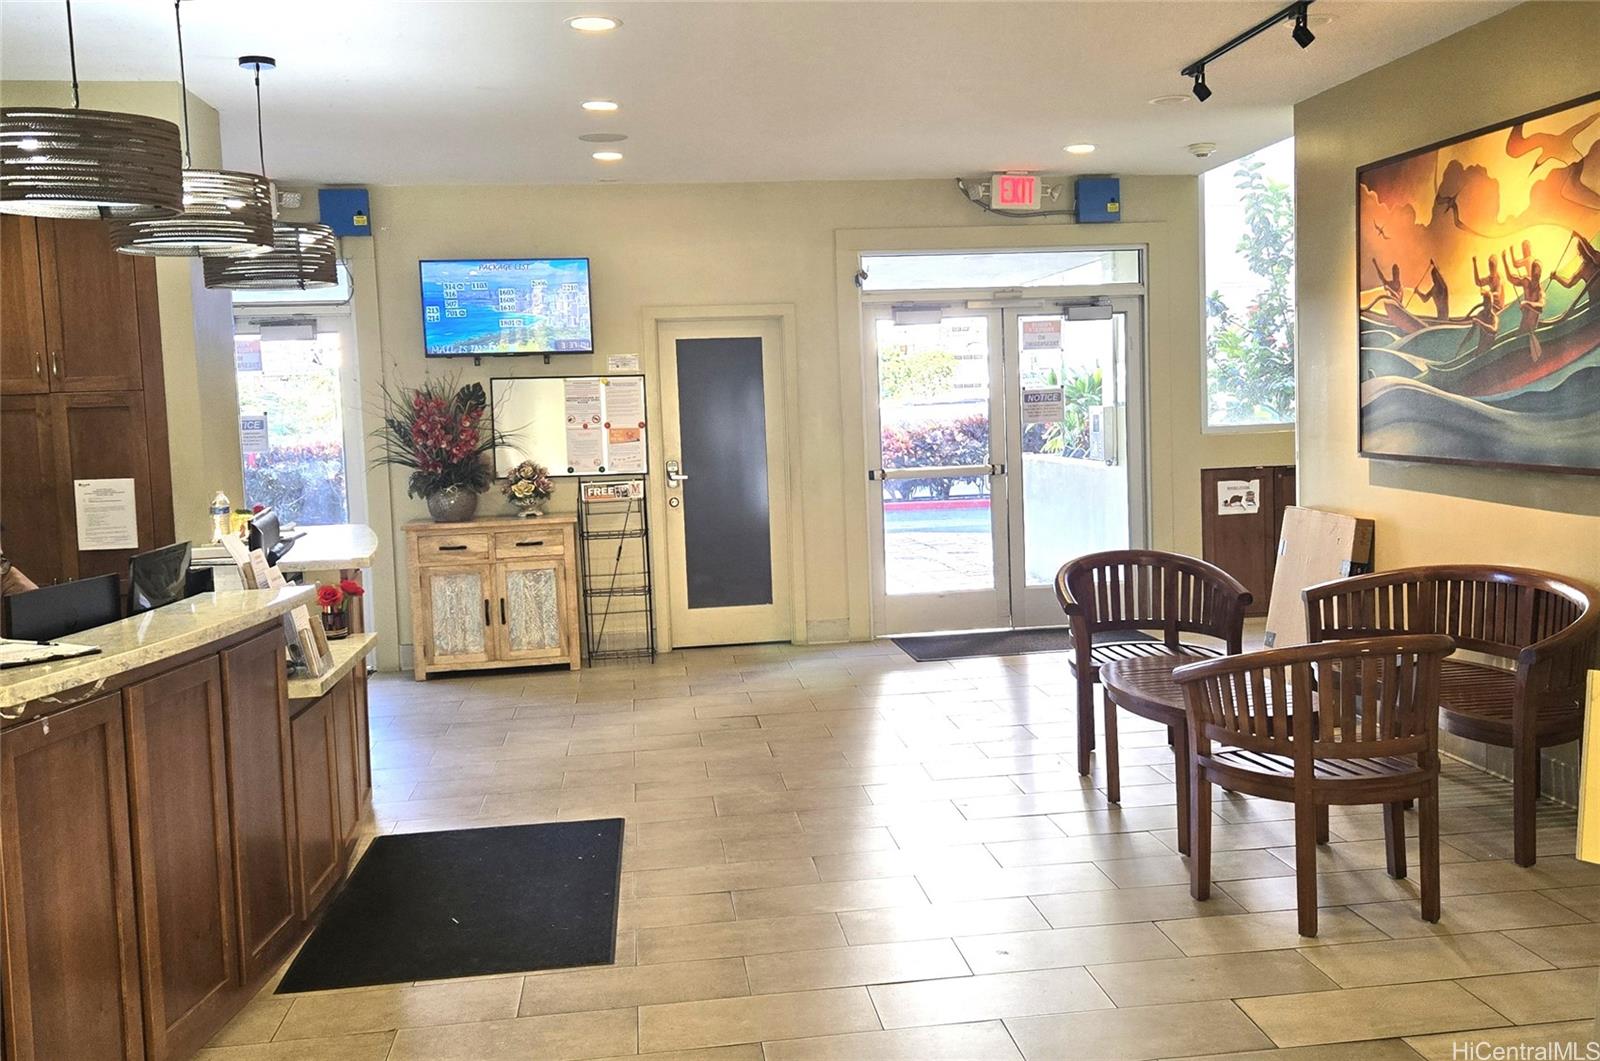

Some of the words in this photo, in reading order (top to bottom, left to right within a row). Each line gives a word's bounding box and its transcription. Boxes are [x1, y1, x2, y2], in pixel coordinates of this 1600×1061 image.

[1001, 177, 1034, 204] EXIT
[478, 263, 513, 272] PACKAGE
[514, 263, 530, 271] LIST
[431, 344, 457, 353] MAIL
[459, 344, 468, 353] IS
[1027, 393, 1058, 402] NOTICE
[587, 486, 615, 497] FREE
